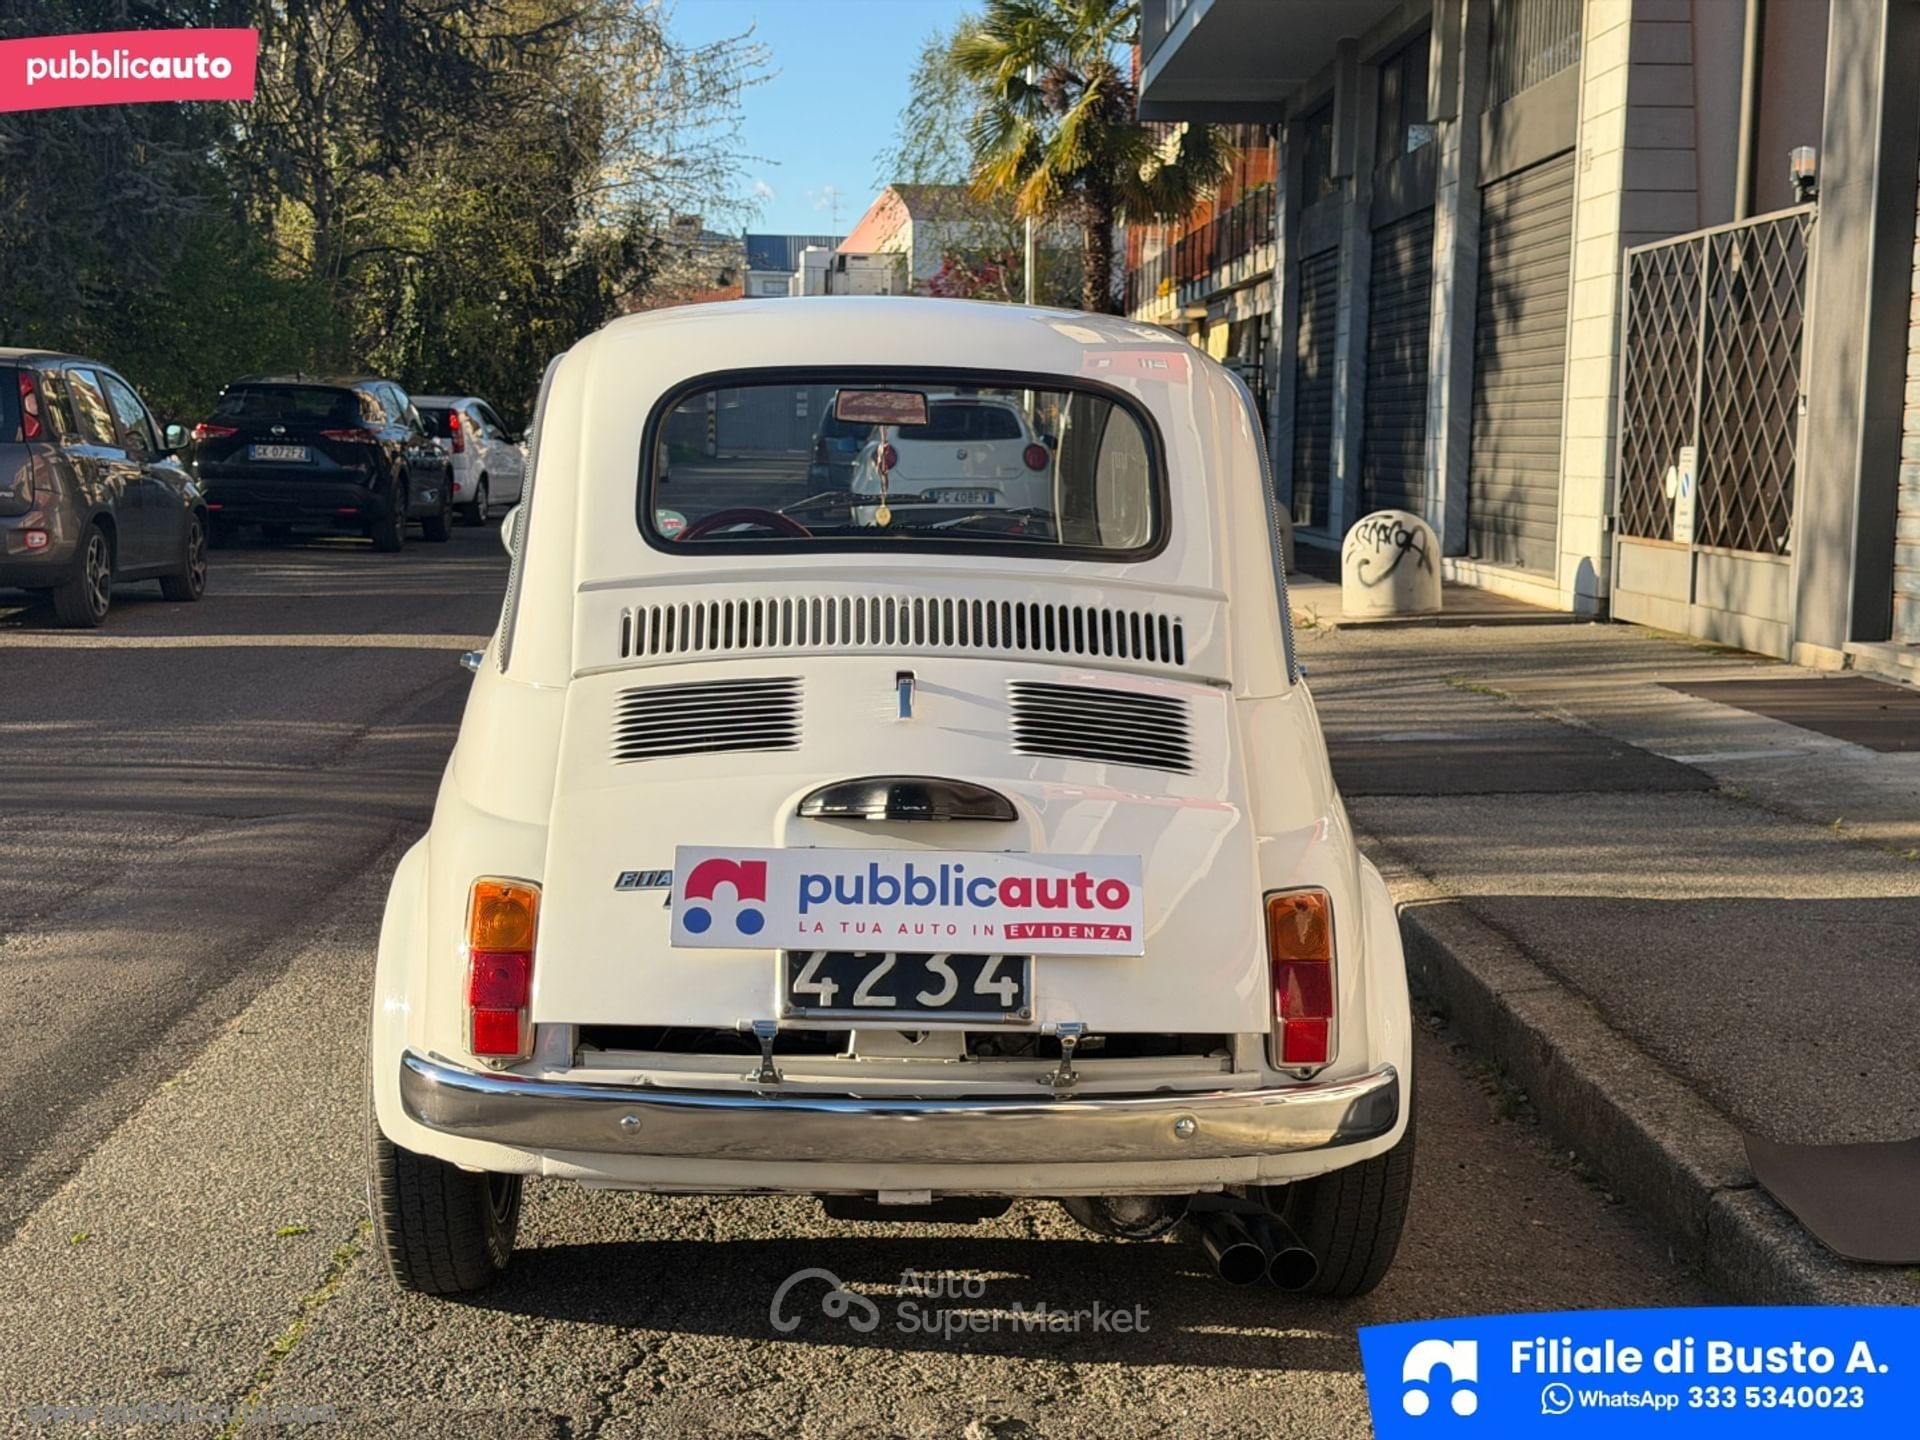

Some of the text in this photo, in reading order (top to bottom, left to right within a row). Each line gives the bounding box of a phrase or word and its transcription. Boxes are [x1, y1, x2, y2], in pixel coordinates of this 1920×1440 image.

[617, 871, 672, 888] FIA
[798, 862, 1130, 914] pubblicauto
[798, 921, 1128, 939] LA TUA AUTO IN EVIDENZA
[793, 951, 1019, 1007] 4234
